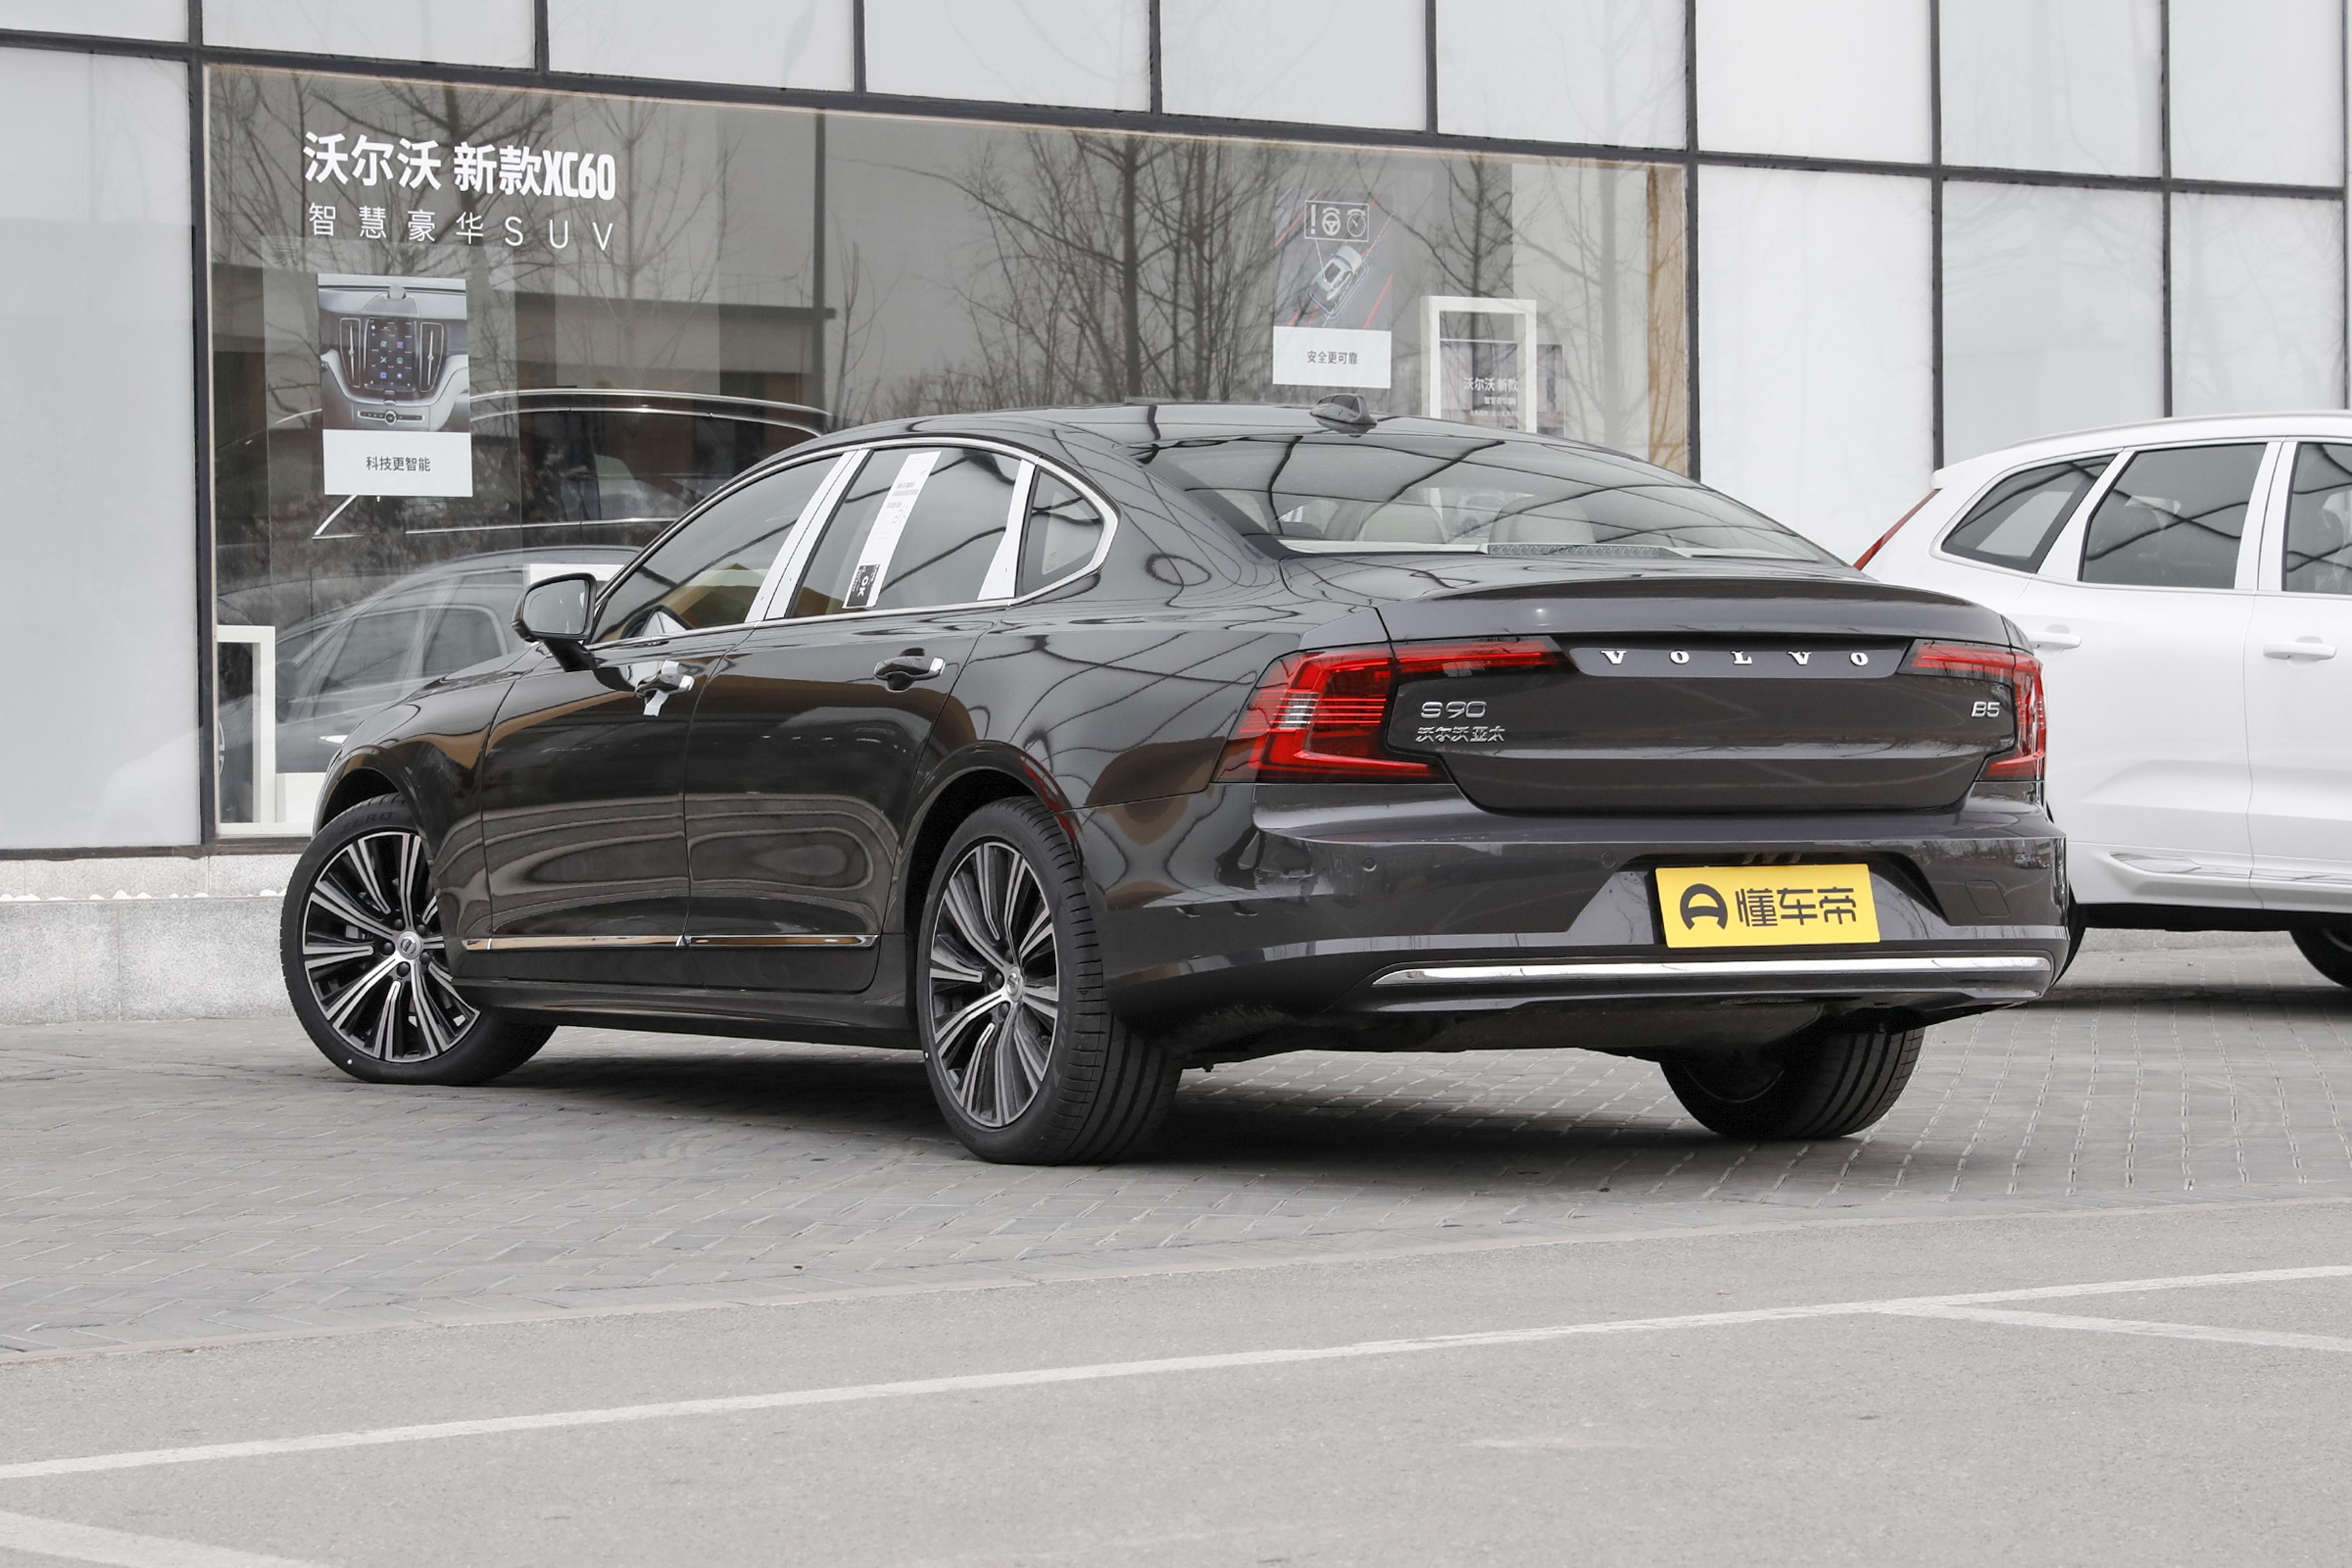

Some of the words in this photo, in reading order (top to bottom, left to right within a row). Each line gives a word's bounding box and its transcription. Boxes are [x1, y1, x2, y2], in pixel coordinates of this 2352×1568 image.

[303, 131, 442, 190] 沃尔沃
[453, 142, 616, 200] 新款XC60
[1307, 350, 1358, 365] 安全更可靠
[1464, 377, 1495, 391] 沃尔沃
[366, 456, 430, 472] 科技更智能
[857, 575, 869, 597] OK
[1601, 650, 1869, 666] VOLVO
[1421, 701, 1487, 719] S90
[1971, 701, 2000, 718] B5
[1416, 726, 1505, 742] 沃尔沃亚太
[1735, 887, 1856, 927] 懂车帝
